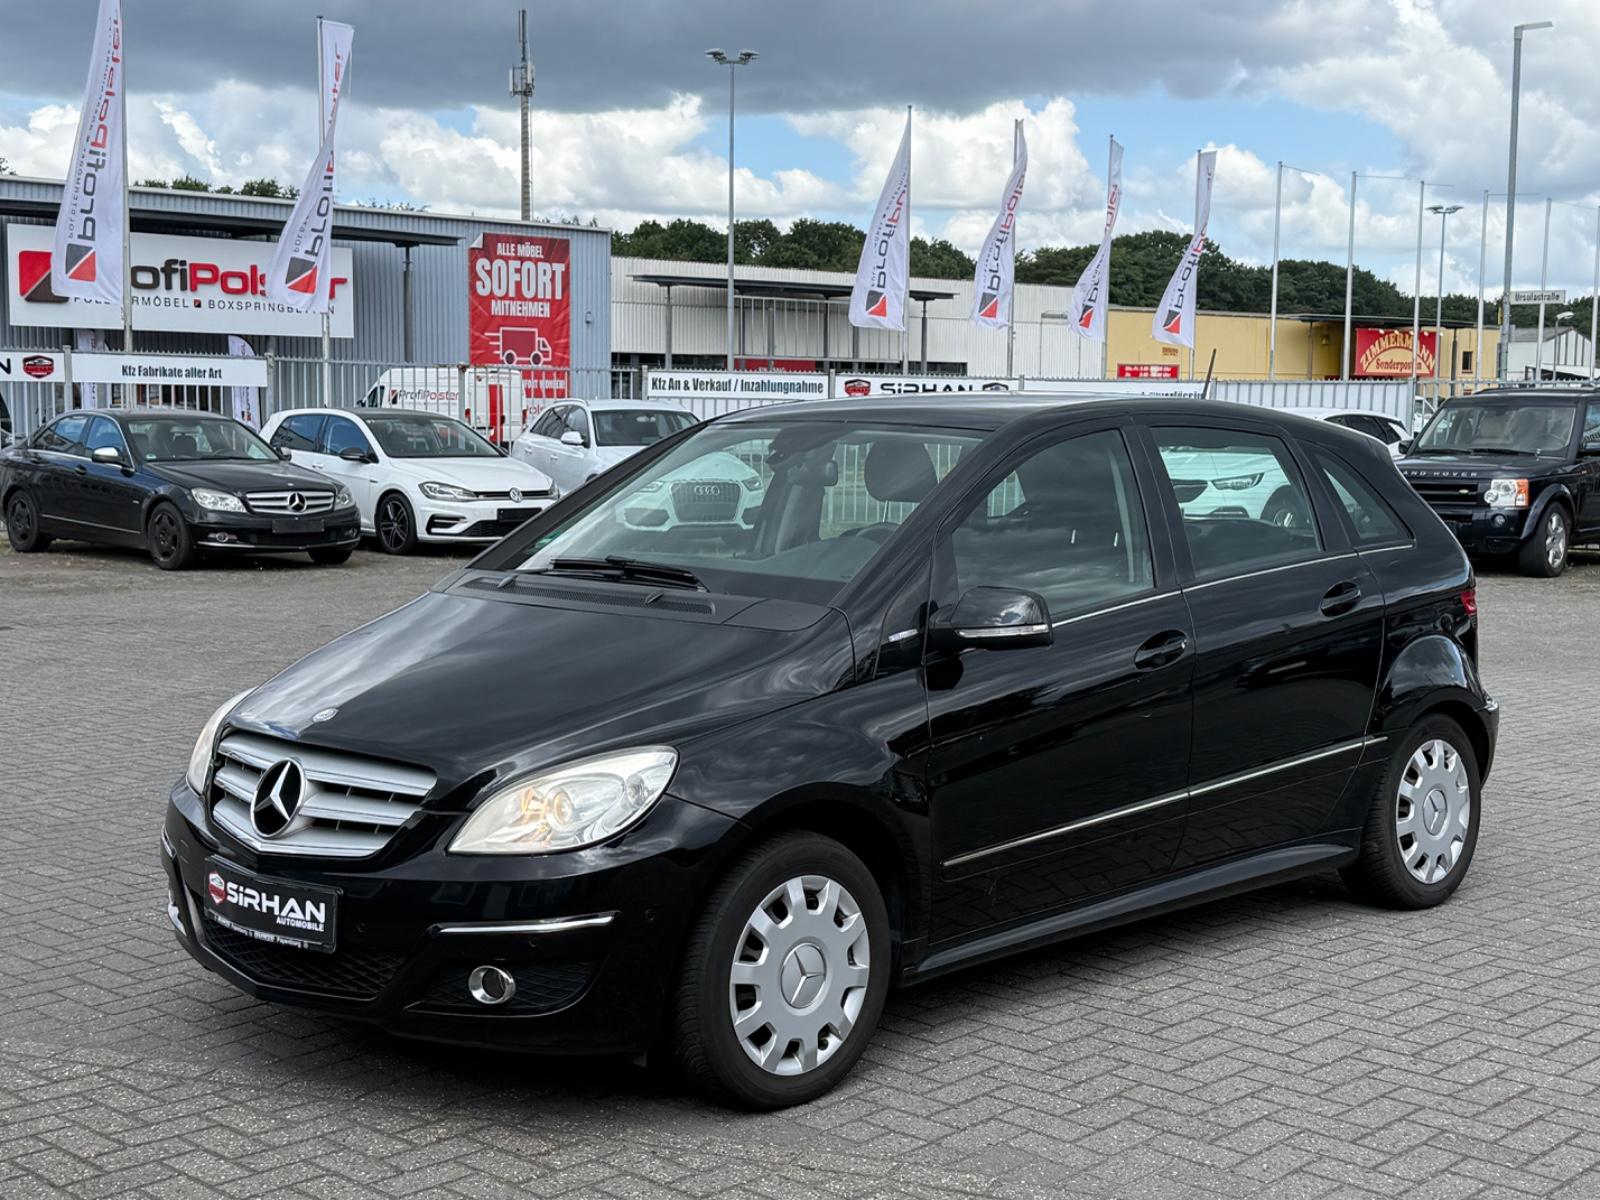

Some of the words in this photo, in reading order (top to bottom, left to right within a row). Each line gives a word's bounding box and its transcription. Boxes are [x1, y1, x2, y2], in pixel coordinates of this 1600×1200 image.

[496, 242, 516, 256] ALLE
[517, 241, 544, 259] MÖBEL
[475, 257, 566, 300] SOFORT
[208, 301, 335, 314] BOXSPRINGBN
[491, 299, 550, 318] MITNEHMEN
[121, 365, 136, 377] Kfz
[138, 365, 183, 378] Fabrikate
[184, 367, 207, 379] aller
[208, 368, 223, 379] Art
[1375, 358, 1422, 372] Sonderposn
[651, 377, 666, 391] Kfz
[668, 377, 681, 391] An
[683, 378, 690, 391] &
[692, 378, 732, 392] Verkauf
[733, 379, 739, 391] /
[740, 379, 824, 394] Inzahlungnahme
[399, 389, 460, 401] ProfiPoster
[276, 916, 325, 933] AUTOMOBILE
